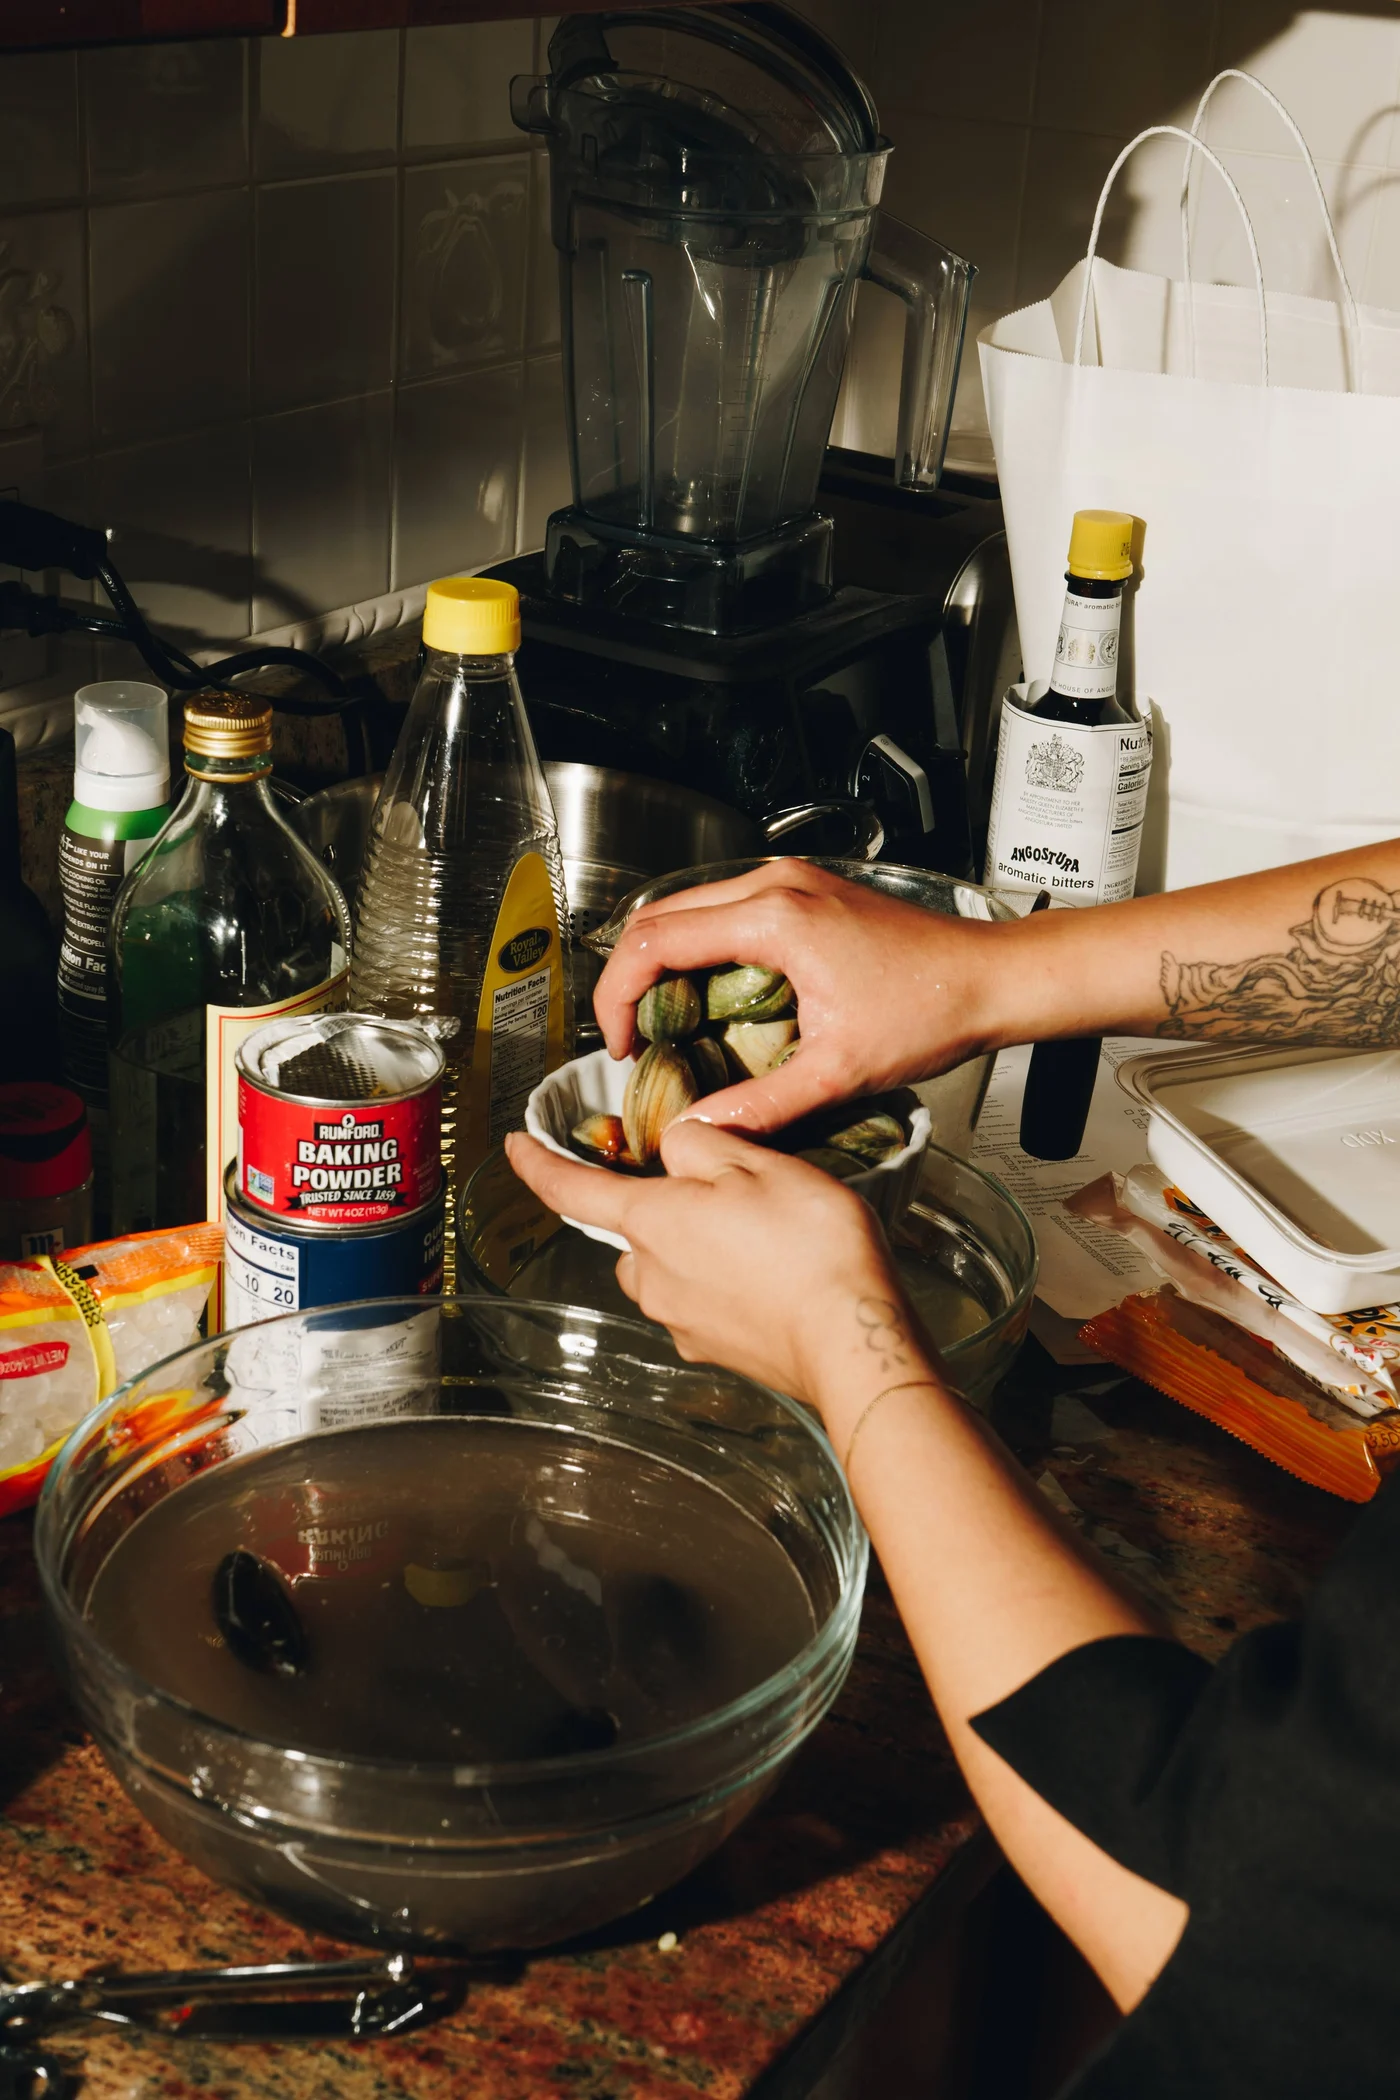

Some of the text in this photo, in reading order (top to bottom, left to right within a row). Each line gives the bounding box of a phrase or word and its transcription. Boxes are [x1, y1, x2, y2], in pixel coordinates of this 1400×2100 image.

[1058, 683, 1081, 692] HOUSE
[73, 846, 88, 857] LIKE
[89, 850, 110, 860] YOUR
[1010, 845, 1080, 874] ANGOSTURA
[86, 861, 98, 870] ON
[998, 861, 1095, 889] aromatic bitters
[68, 870, 95, 884] COOKING
[95, 877, 107, 886] OIL
[510, 932, 539, 955] Royal
[513, 945, 544, 968] Valley
[494, 975, 546, 1004] Nutrition Facts
[532, 1004, 547, 1020] 120
[319, 1124, 380, 1141] RUMFORD
[298, 1138, 398, 1166] BAKING
[293, 1162, 402, 1190] POWDER
[299, 1189, 397, 1205] TRUSTED SINCE 1859
[307, 1206, 327, 1216] NET
[328, 1208, 344, 1217] WT
[250, 1234, 296, 1261] Facts
[245, 1273, 294, 1305] 10 20
